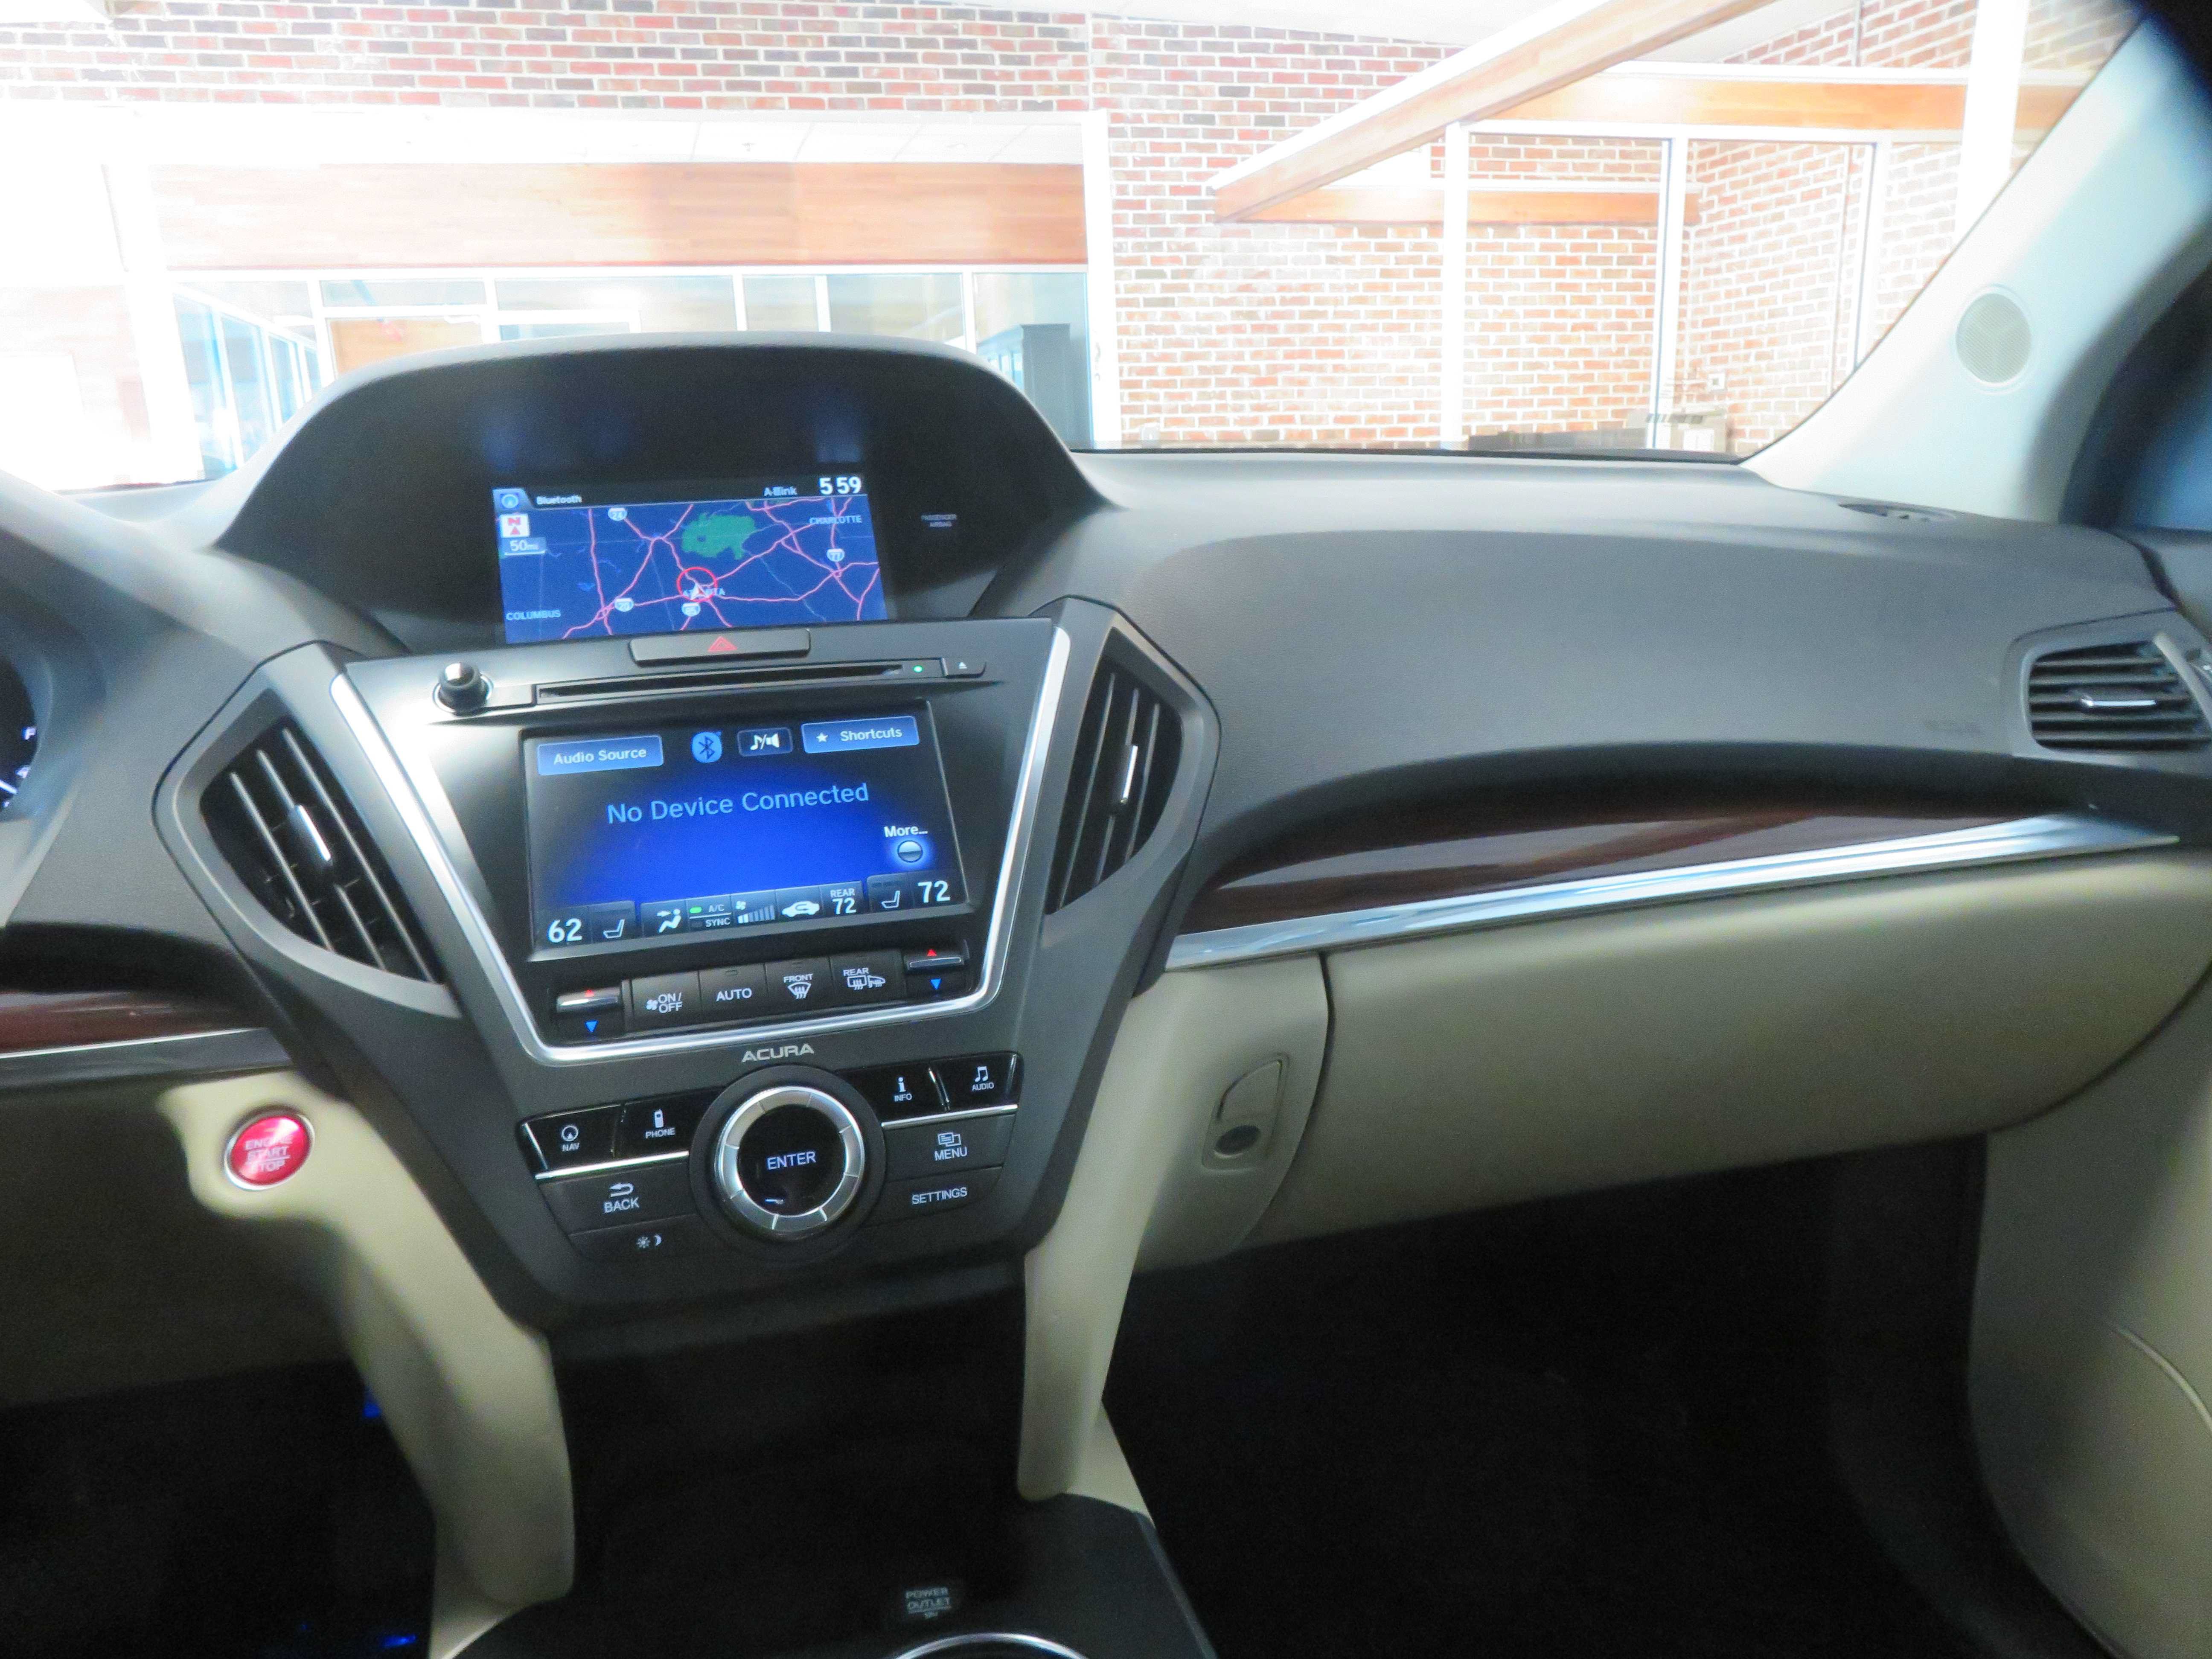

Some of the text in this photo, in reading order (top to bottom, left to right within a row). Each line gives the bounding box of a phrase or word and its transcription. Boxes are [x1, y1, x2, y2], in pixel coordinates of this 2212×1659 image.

[536, 494, 582, 505] Bluetooth
[809, 515, 862, 524] CHARLOTTE
[506, 609, 562, 621] COLUMBUS
[839, 727, 903, 742] Shortcuts
[553, 748, 647, 765] Audio Source
[607, 783, 869, 824] No Device Connected
[830, 888, 856, 898] REAR
[917, 880, 951, 903] 72
[708, 904, 725, 913] A/C
[832, 897, 857, 915] 72
[705, 917, 731, 928] SYNC
[547, 917, 583, 943] 62
[783, 973, 813, 983] FRONT
[843, 967, 869, 977] REAR
[716, 987, 752, 1002] AUTO
[658, 1001, 683, 1013] OFF
[741, 1043, 815, 1063] ACURA
[972, 1082, 995, 1092] AUDIO
[894, 1092, 912, 1103] INFO
[645, 1127, 675, 1139] PHONE
[562, 1142, 580, 1152] NAV
[934, 1146, 968, 1161] MENU
[767, 1151, 817, 1170] ENTER
[911, 1187, 968, 1205] SETTINGS
[603, 1197, 640, 1214] BACK
